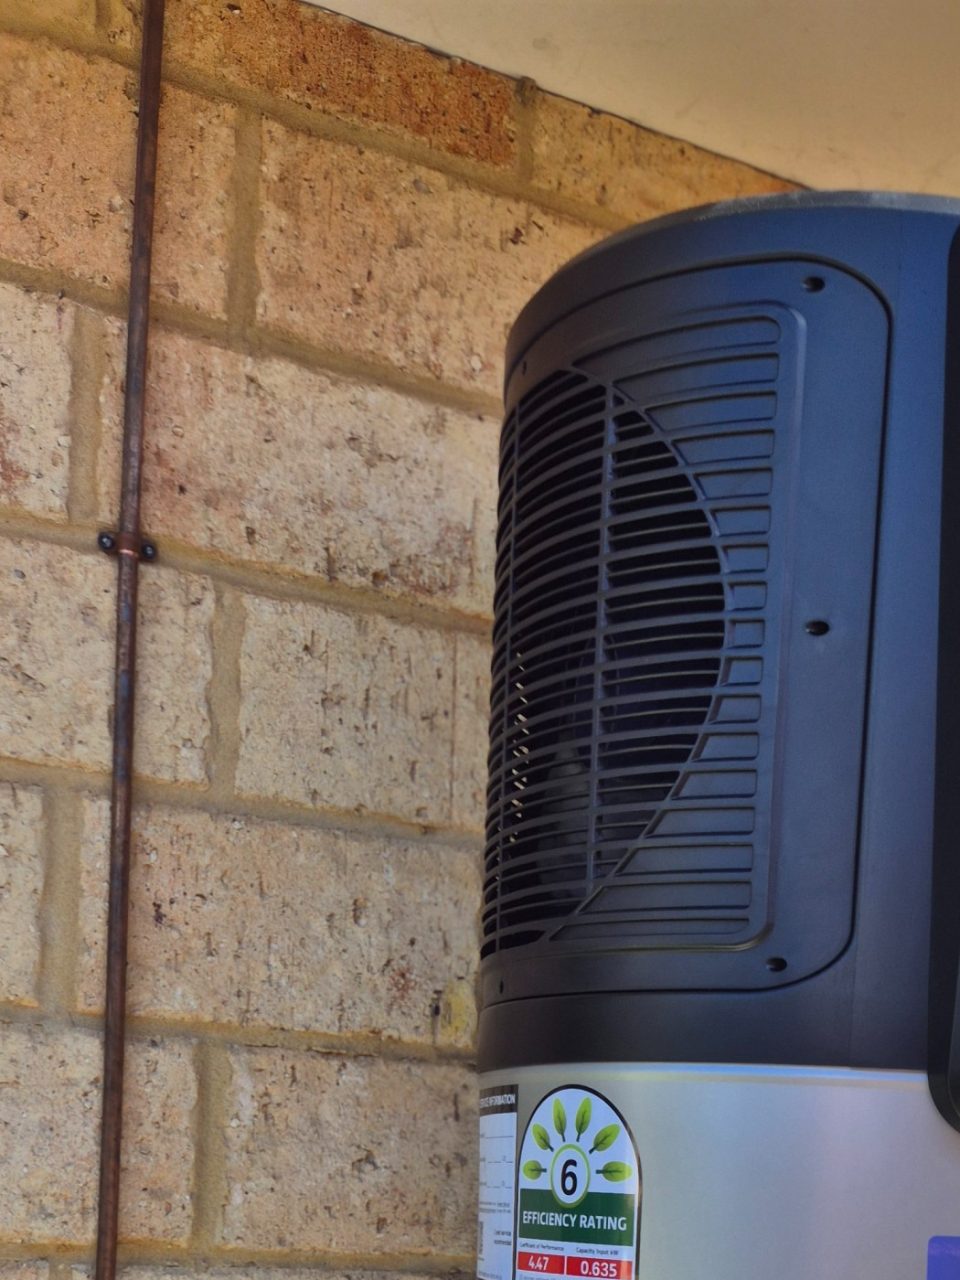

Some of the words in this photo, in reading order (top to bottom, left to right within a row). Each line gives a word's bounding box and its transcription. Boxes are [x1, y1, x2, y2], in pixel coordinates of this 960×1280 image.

[560, 1158, 578, 1196] 6
[522, 1210, 577, 1228] EFFICIENCY
[579, 1214, 627, 1232] RATING
[580, 1260, 618, 1278] 0.635
